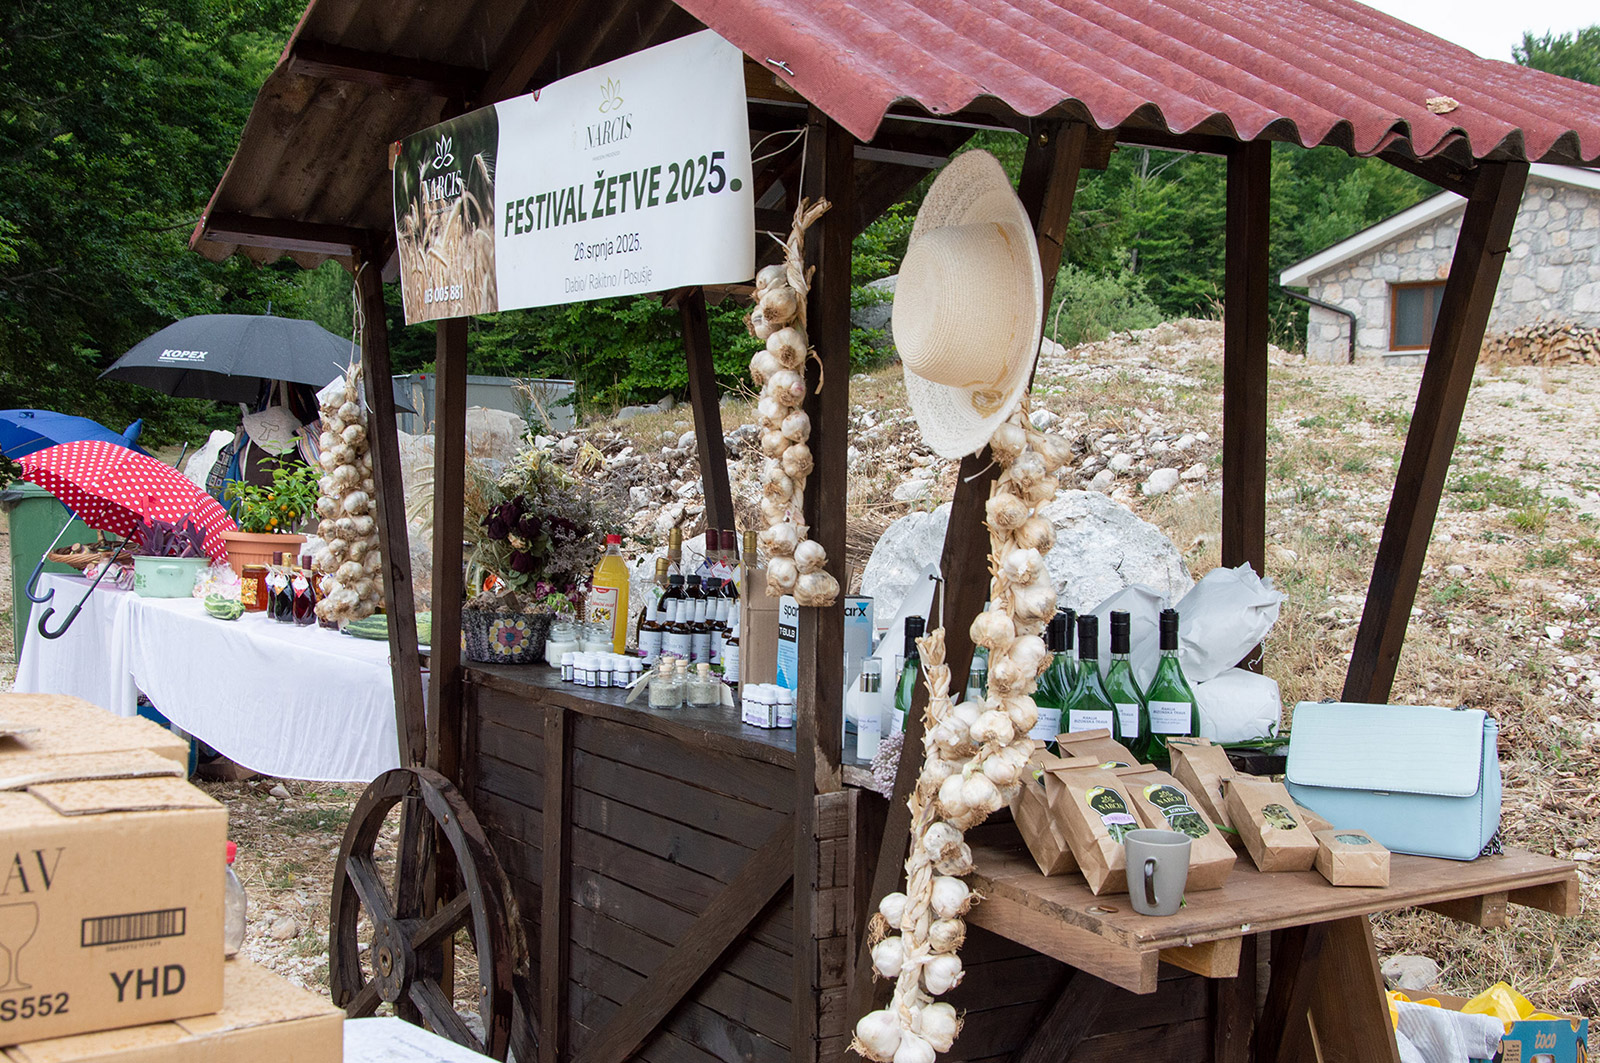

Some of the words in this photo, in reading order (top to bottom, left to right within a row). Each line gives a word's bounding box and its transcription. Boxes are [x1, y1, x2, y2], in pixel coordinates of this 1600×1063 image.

[584, 112, 633, 151] NARCIS
[422, 169, 462, 203] NARCIS
[504, 183, 587, 238] FESTIVAL
[591, 165, 662, 219] ŽETVE
[665, 151, 743, 204] 2025.
[616, 232, 642, 255] 2025.
[588, 272, 617, 290] Rakitno
[623, 267, 653, 288] Posušje
[434, 285, 449, 303] 005
[450, 284, 464, 301] 881
[161, 349, 208, 359] KOPEX
[783, 604, 799, 618] spar
[844, 606, 867, 617] arx
[109, 963, 187, 1003] YHD
[1535, 1030, 1557, 1049] toco
